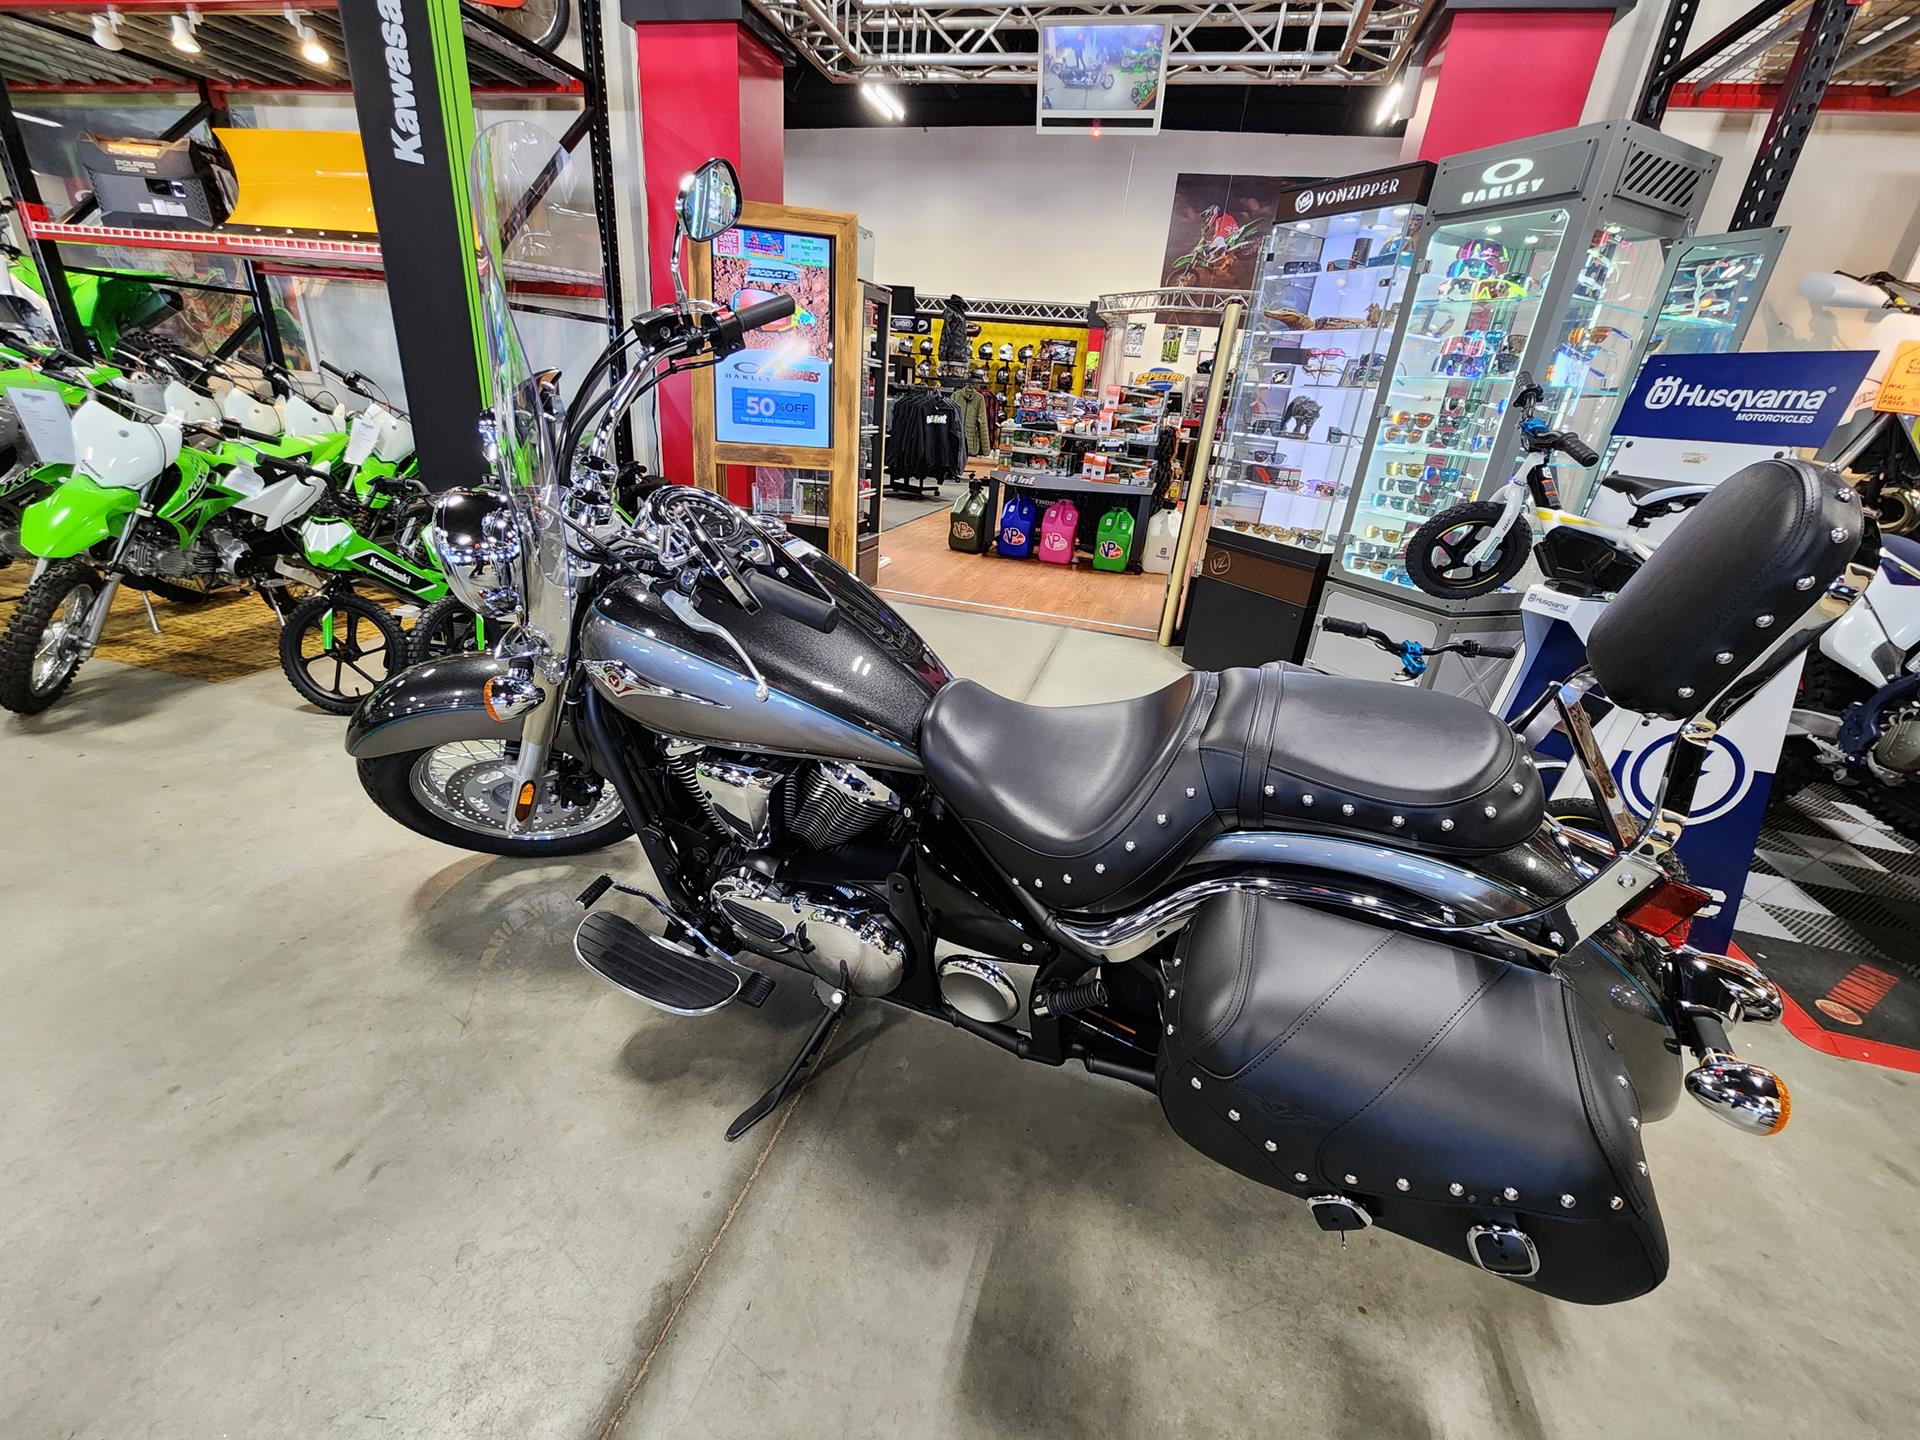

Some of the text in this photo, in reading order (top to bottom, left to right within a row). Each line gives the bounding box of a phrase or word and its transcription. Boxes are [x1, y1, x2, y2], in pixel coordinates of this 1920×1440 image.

[1316, 178, 1400, 207] VONZIPPER
[1462, 178, 1545, 204] OAKLEY
[720, 246, 738, 254] DATE
[1674, 384, 1828, 412] Husqvarna
[1735, 412, 1815, 424] MOTORCYCLES
[1004, 528, 1018, 543] VP
[1045, 533, 1060, 548] VP
[1101, 541, 1116, 557] VP
[369, 556, 411, 585] Kawasaki
[1535, 597, 1569, 611] Husqvarna
